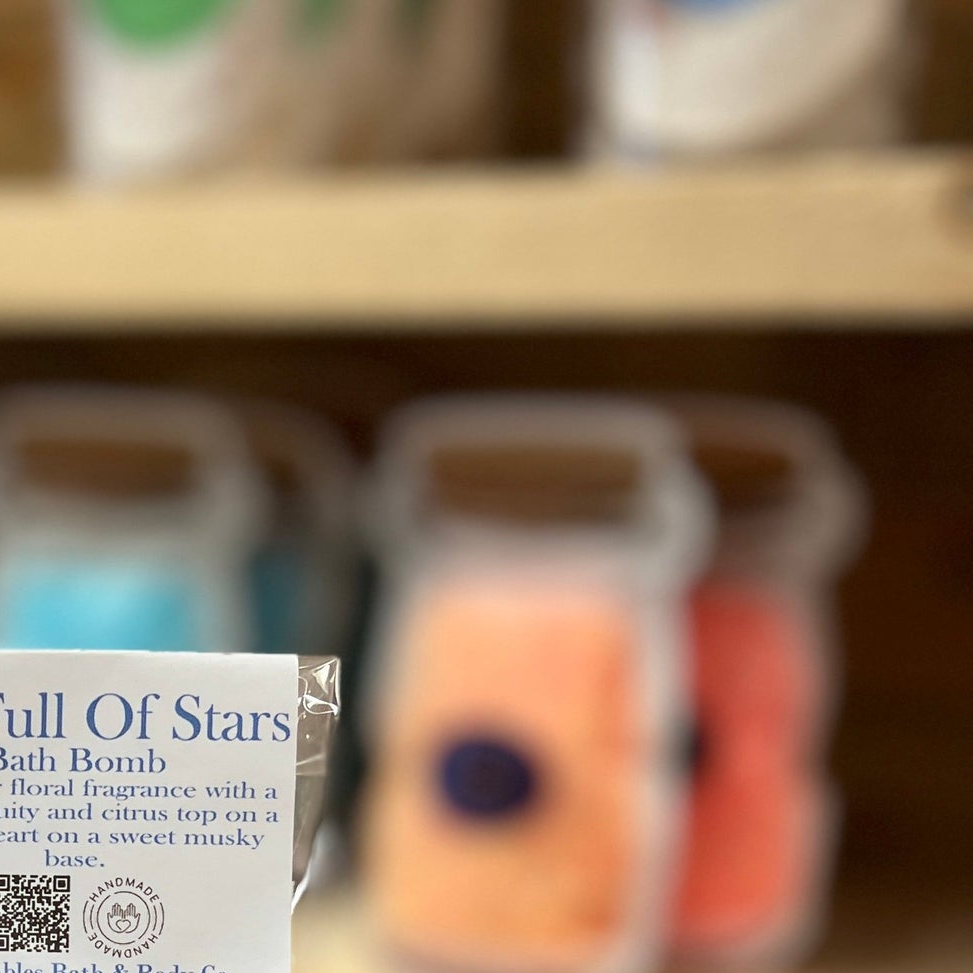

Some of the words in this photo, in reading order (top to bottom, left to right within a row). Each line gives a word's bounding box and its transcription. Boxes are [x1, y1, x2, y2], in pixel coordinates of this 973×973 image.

[86, 693, 160, 740] Of
[172, 694, 291, 742] Stars
[69, 748, 166, 773] Bomb
[11, 778, 73, 796] floral
[83, 779, 196, 801] fragrance
[205, 781, 256, 799] with
[265, 788, 278, 799] a
[48, 803, 92, 820] and
[102, 807, 168, 821] citrus
[177, 808, 217, 826] top
[226, 811, 256, 822] on
[266, 811, 278, 823] a
[47, 832, 78, 843] on
[88, 832, 101, 844] a
[109, 831, 176, 845] sweet
[184, 828, 265, 850] musky
[45, 849, 105, 867] base.
[89, 877, 160, 903] HANDMADE
[88, 932, 158, 958] HANDMADE
